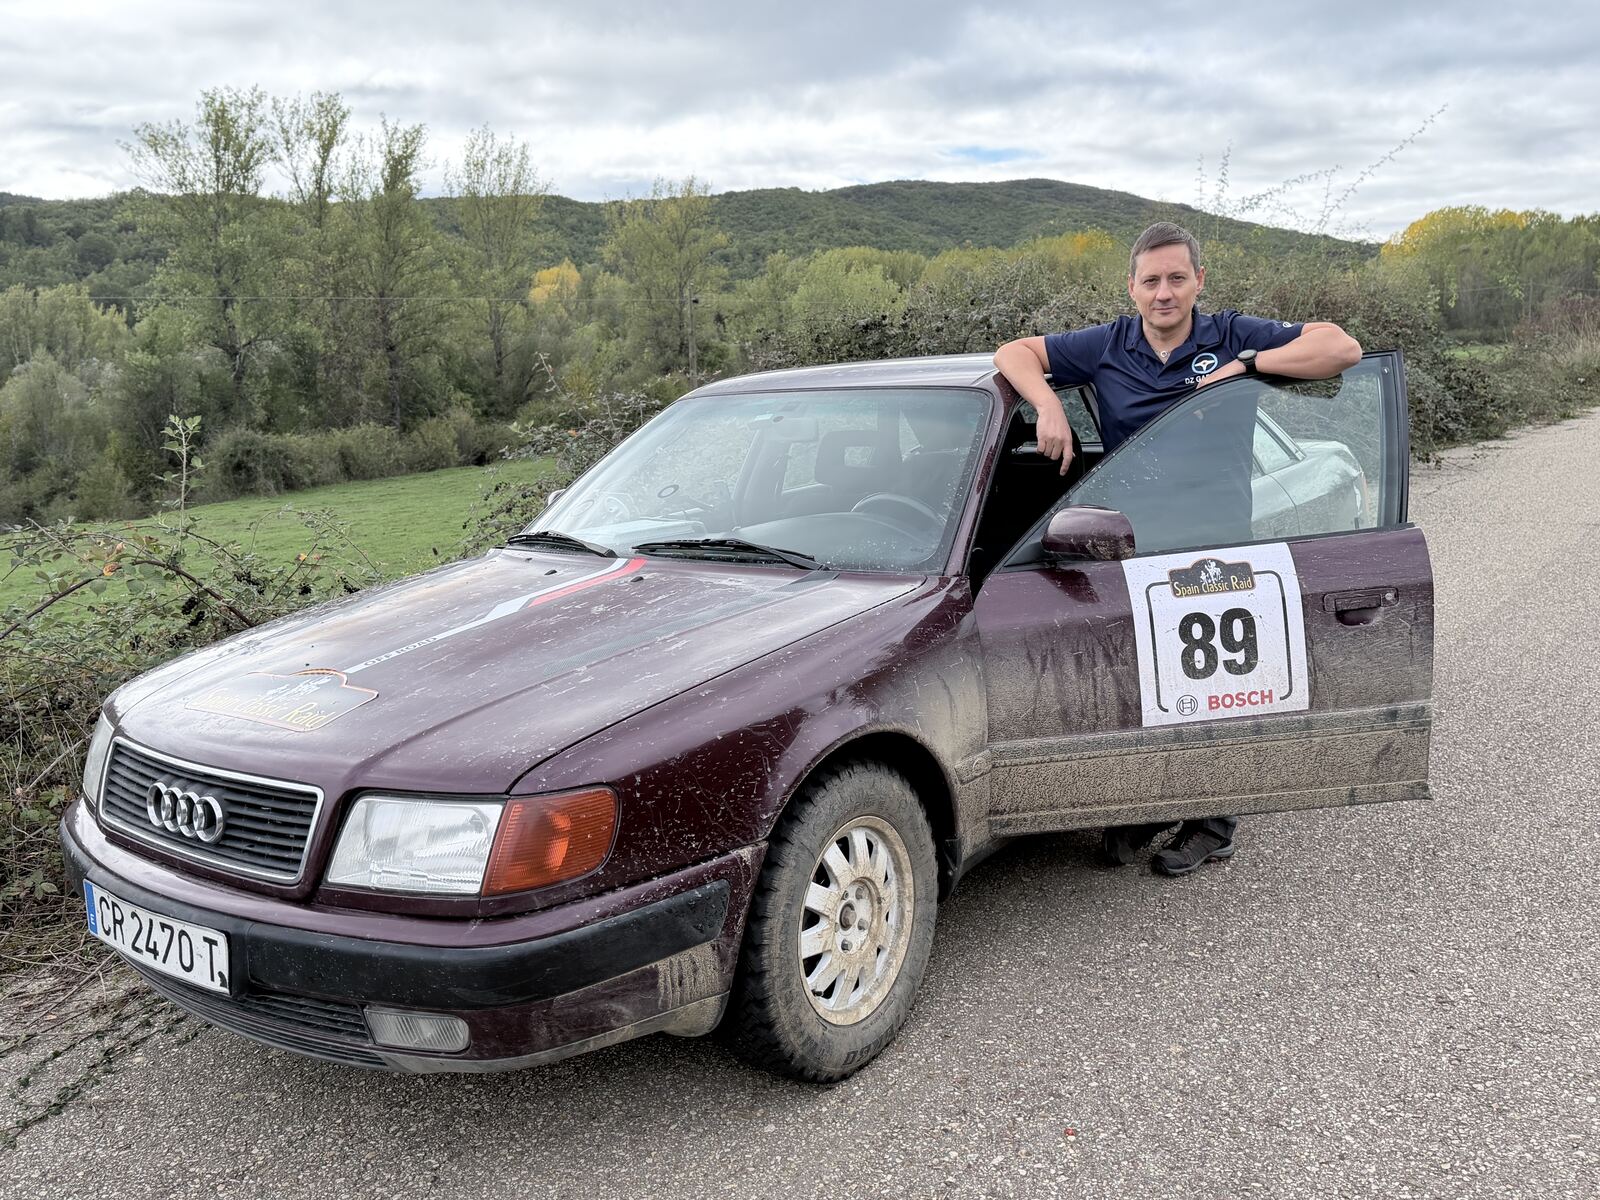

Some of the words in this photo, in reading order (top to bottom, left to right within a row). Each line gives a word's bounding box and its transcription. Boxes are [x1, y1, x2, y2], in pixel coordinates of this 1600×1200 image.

[1173, 581, 1199, 597] Spain
[1201, 581, 1229, 593] Classic
[1231, 575, 1253, 591] Raid
[395, 636, 438, 655] ROAD
[1178, 607, 1258, 680] 89
[1207, 689, 1273, 710] BOSCH
[277, 702, 336, 728] Raid
[89, 913, 96, 926] E
[99, 896, 124, 945] CR
[131, 912, 194, 972] 2470
[203, 936, 218, 982] T
